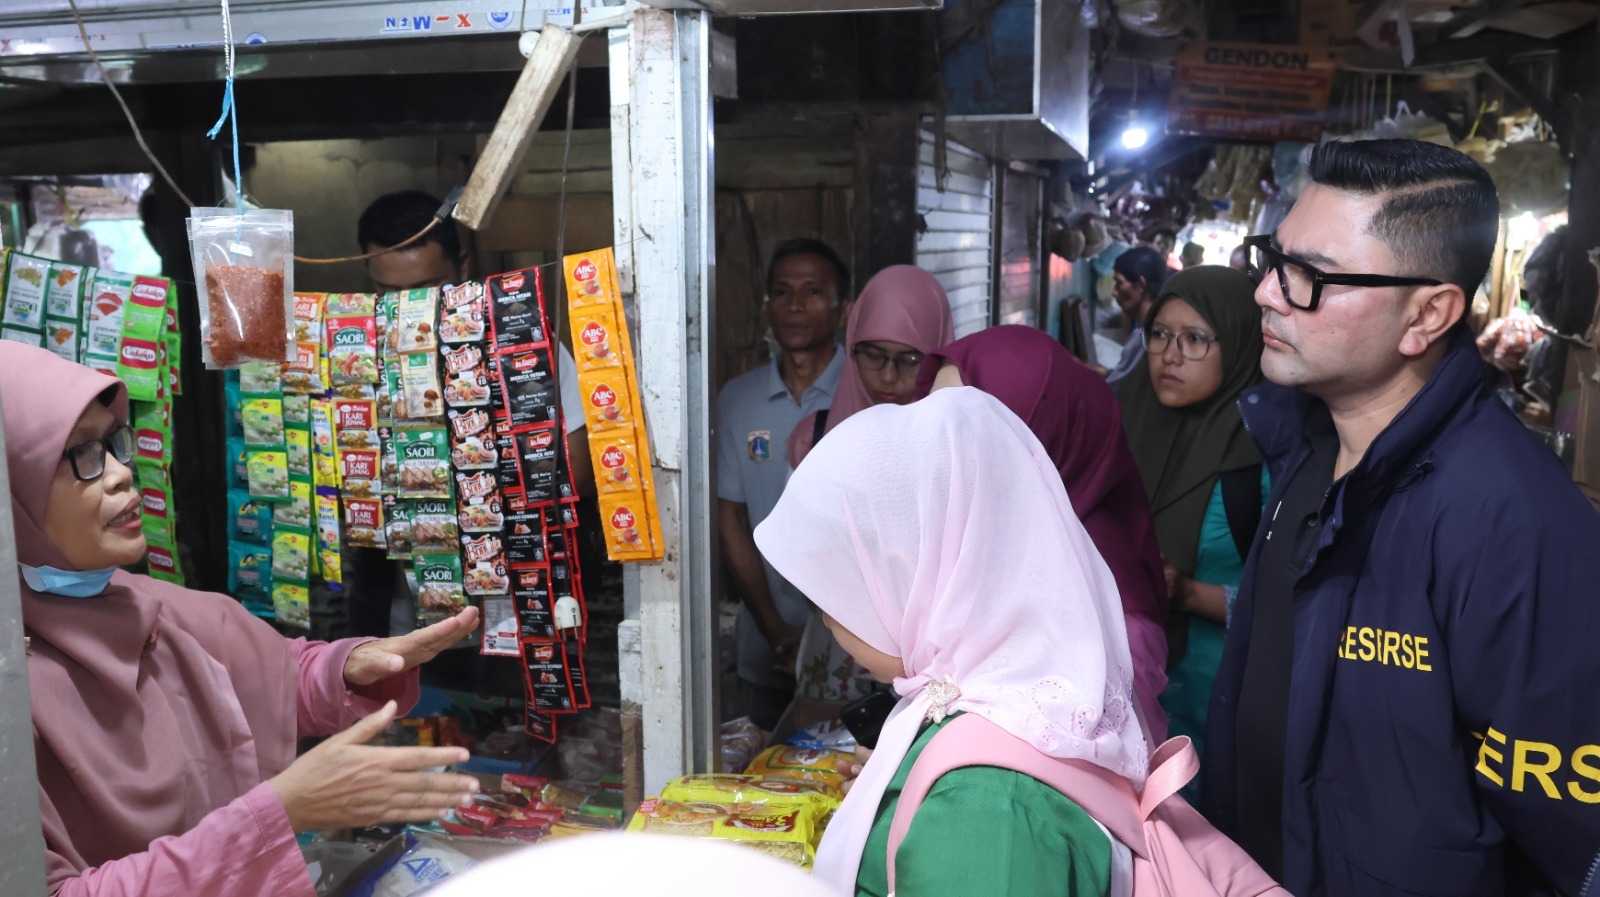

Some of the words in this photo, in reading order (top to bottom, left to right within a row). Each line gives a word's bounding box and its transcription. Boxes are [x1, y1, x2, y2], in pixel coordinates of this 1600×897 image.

[1204, 46, 1309, 70] GENDON
[576, 264, 594, 274] ABC
[133, 284, 165, 300] Ladaku
[584, 327, 603, 337] ABC
[335, 333, 364, 344] SAORI
[124, 347, 155, 360] Ladaku
[594, 389, 613, 399] ABC
[345, 412, 363, 420] KARI
[405, 447, 435, 458] SAORI
[604, 451, 622, 461] ABC
[349, 461, 368, 469] KARI
[417, 503, 446, 513] SAORI
[613, 513, 632, 522] ABC
[424, 570, 452, 581] SAORI
